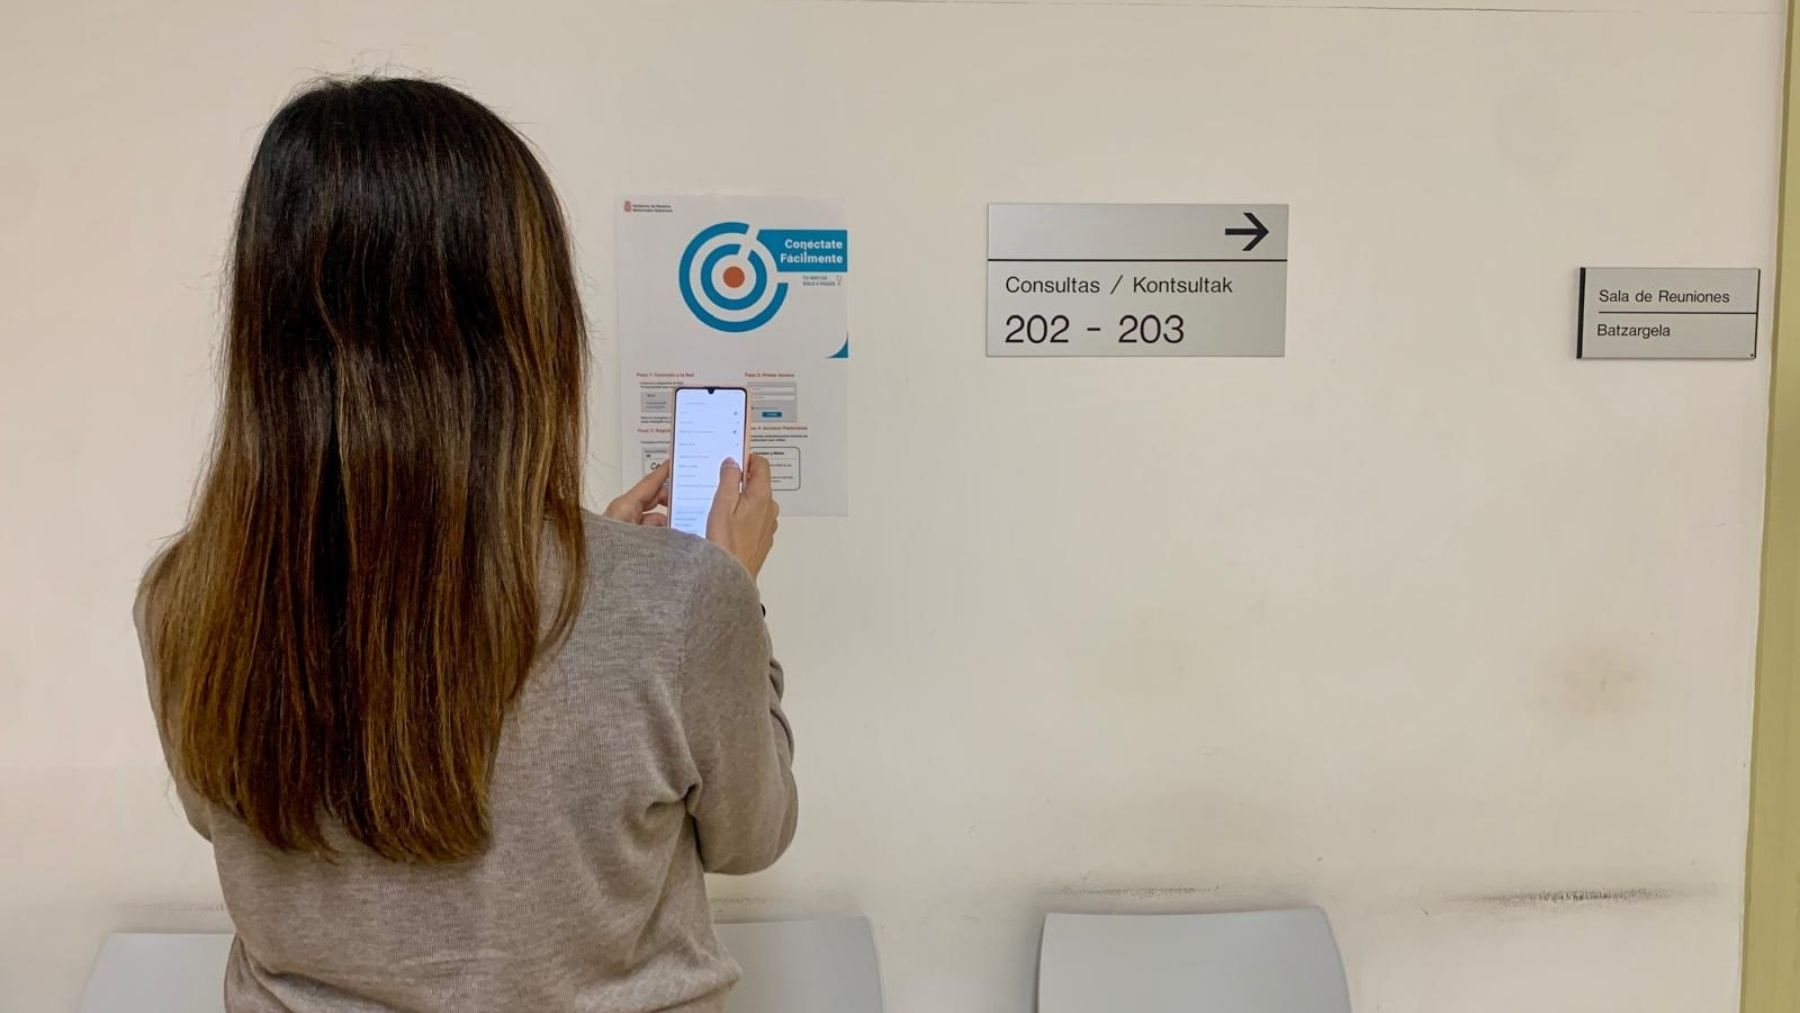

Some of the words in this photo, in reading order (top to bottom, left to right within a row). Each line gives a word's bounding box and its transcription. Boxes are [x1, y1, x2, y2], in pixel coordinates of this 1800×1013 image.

[784, 238, 844, 250] Conéctate
[1005, 276, 1101, 294] Consultas
[1110, 275, 1124, 295] /
[1133, 276, 1233, 294] Kontsultak
[1599, 289, 1629, 303] Sala
[1635, 290, 1653, 303] de
[1658, 290, 1730, 304] Reuniones
[1005, 314, 1070, 344] 202
[1118, 314, 1185, 344] 203
[1597, 323, 1671, 339] Batzargela
